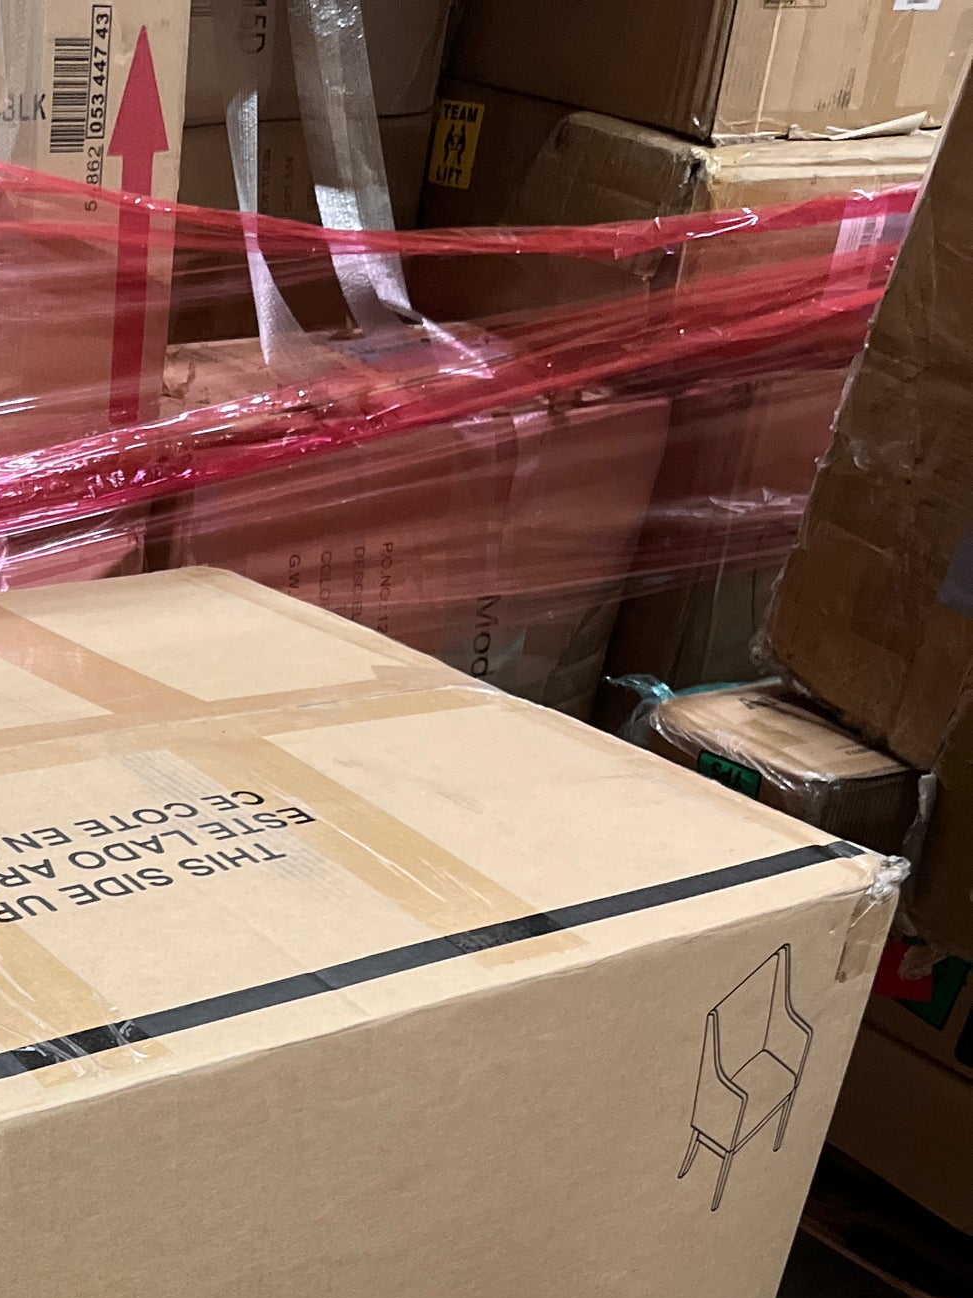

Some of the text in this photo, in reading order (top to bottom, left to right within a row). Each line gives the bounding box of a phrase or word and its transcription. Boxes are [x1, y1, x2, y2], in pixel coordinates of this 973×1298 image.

[95, 13, 109, 39] 43
[92, 47, 108, 87] 447
[89, 94, 105, 133] 053
[443, 103, 479, 123] TEAM
[86, 146, 101, 185] 862
[435, 165, 463, 185] LIFT
[200, 790, 265, 811] CE
[74, 802, 199, 837] COTE
[198, 806, 316, 841] ESTE
[2, 827, 73, 853] EN
[68, 829, 199, 869] LADO
[177, 842, 287, 877] THIS
[58, 866, 174, 906] SIDE
